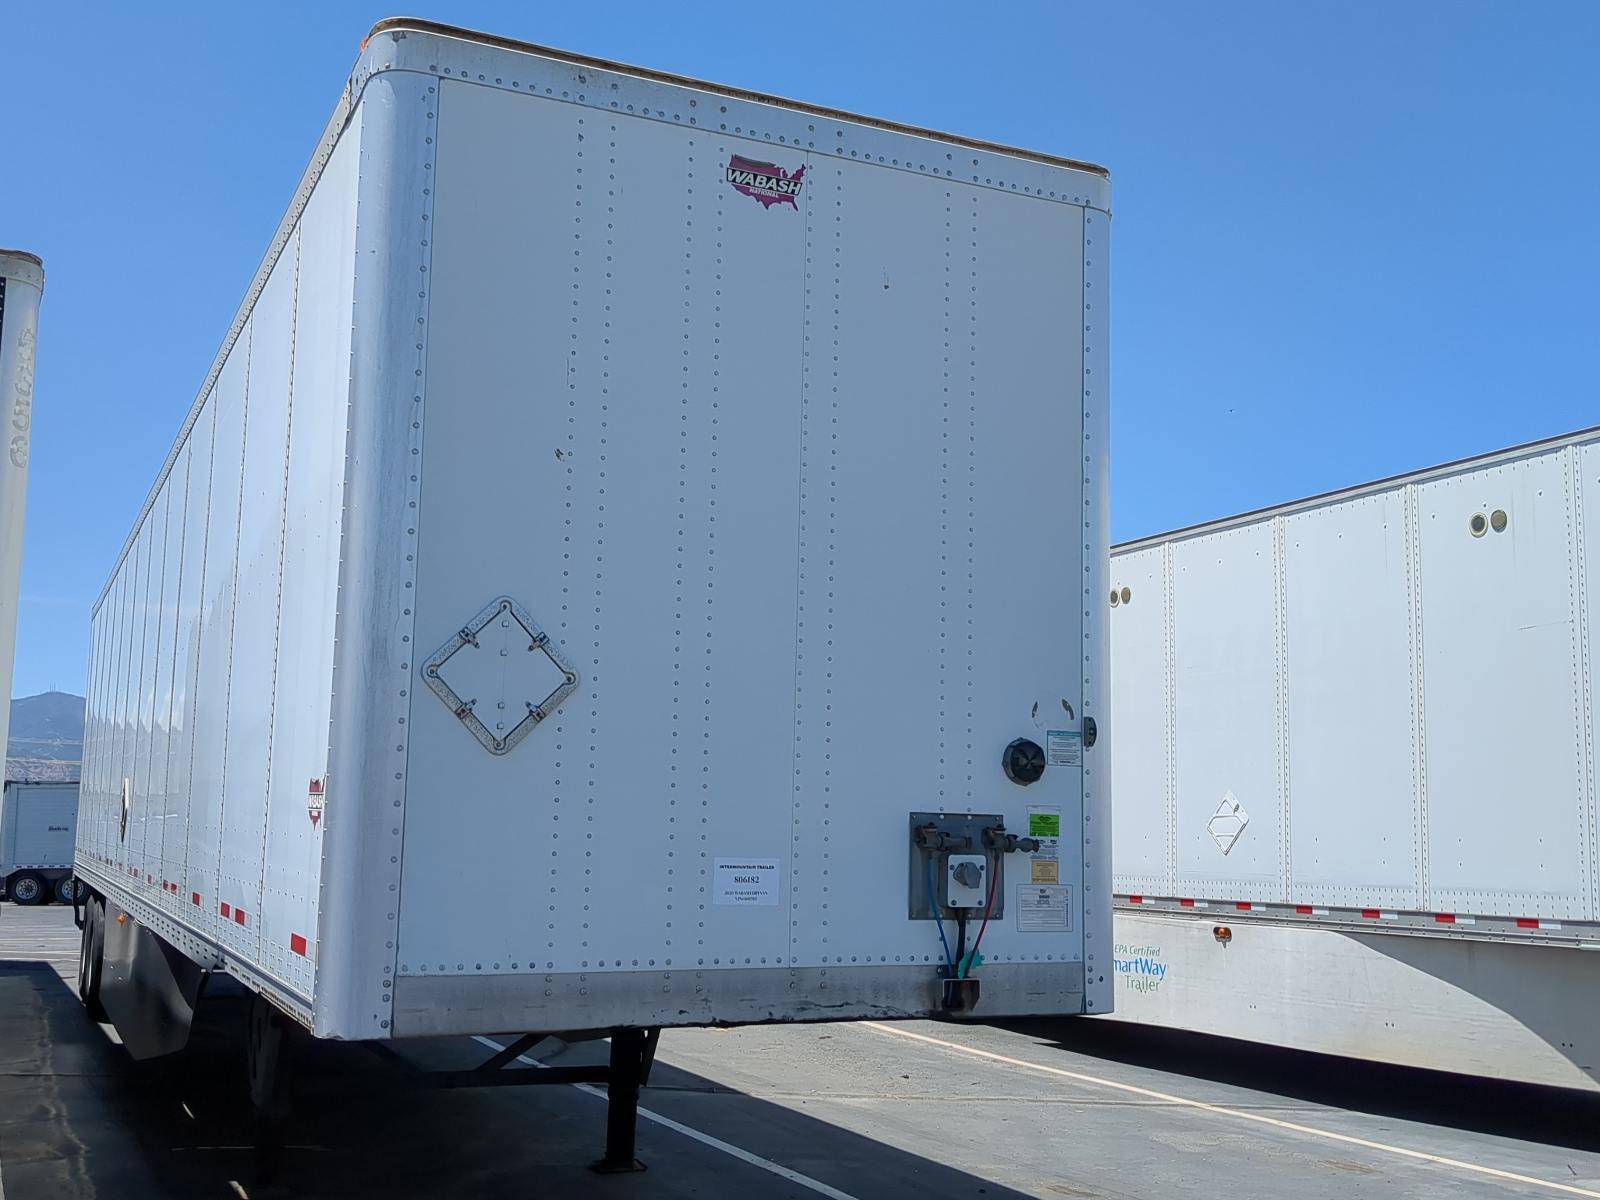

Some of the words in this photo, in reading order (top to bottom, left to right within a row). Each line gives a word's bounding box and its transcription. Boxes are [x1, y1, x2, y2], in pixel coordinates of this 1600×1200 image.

[727, 168, 802, 195] WABASH
[749, 187, 779, 199] NATIONAL
[1114, 943, 1128, 954] EPA
[1129, 945, 1161, 957] Certified
[1113, 957, 1167, 981] martWay
[1124, 975, 1160, 992] Trailer
